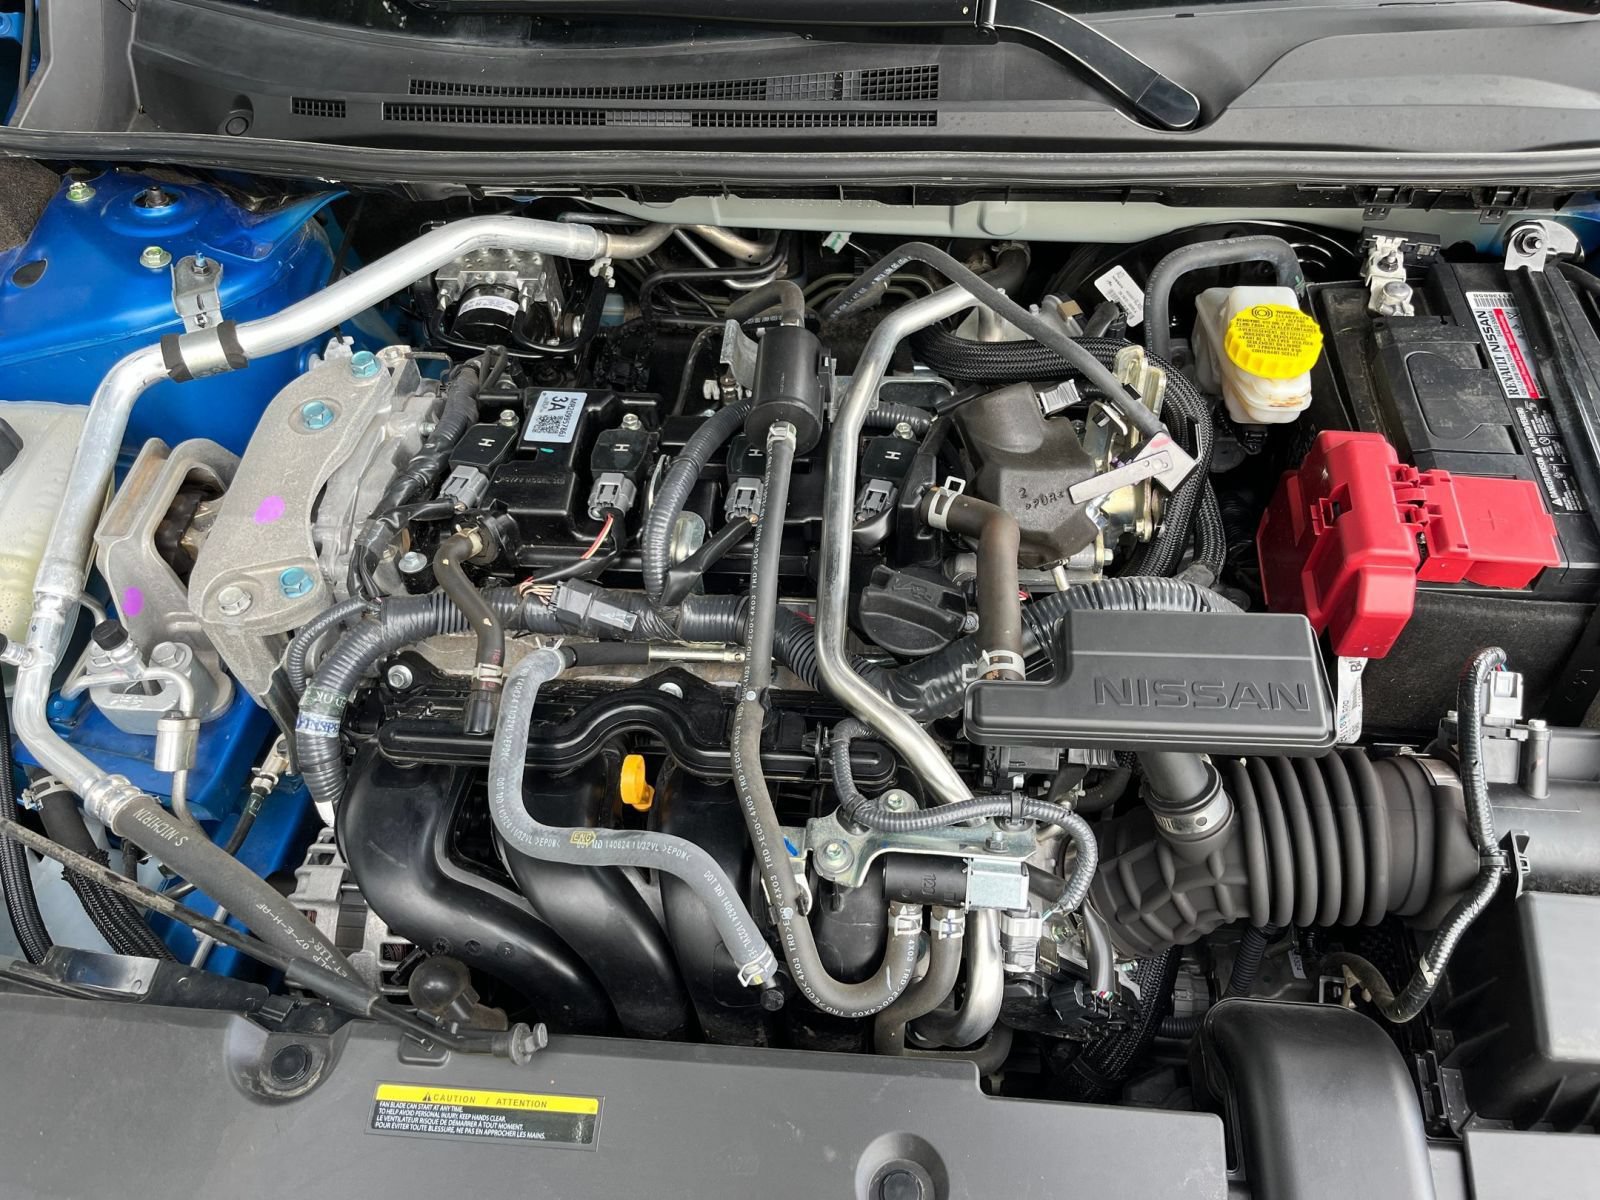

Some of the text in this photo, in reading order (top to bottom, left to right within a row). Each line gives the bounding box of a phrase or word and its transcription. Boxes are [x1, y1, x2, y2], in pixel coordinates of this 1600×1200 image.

[1475, 310, 1502, 353] NISSAN
[1494, 357, 1520, 396] RENAULT
[548, 396, 569, 411] 3A
[478, 438, 495, 447] H
[613, 443, 630, 452] H
[748, 448, 763, 457] H
[884, 450, 901, 460] H
[1094, 676, 1312, 712] NISSAN
[433, 1094, 476, 1104] CAUTION
[496, 1098, 547, 1108] ATTENTION
[384, 1115, 419, 1123] VENTILATEUR
[420, 1117, 439, 1125] RISQUE
[498, 1122, 524, 1131] MOMENT.
[472, 1113, 490, 1121] HANDS
[490, 1114, 506, 1122] CLEAR.
[375, 1121, 391, 1129] POUR
[410, 1123, 427, 1131] TOUTE
[465, 1127, 474, 1135] PAS
[475, 1127, 483, 1135] EN
[484, 1128, 516, 1137] APPROCHER
[517, 1130, 526, 1138] LES
[527, 1131, 546, 1140] MAINS.
